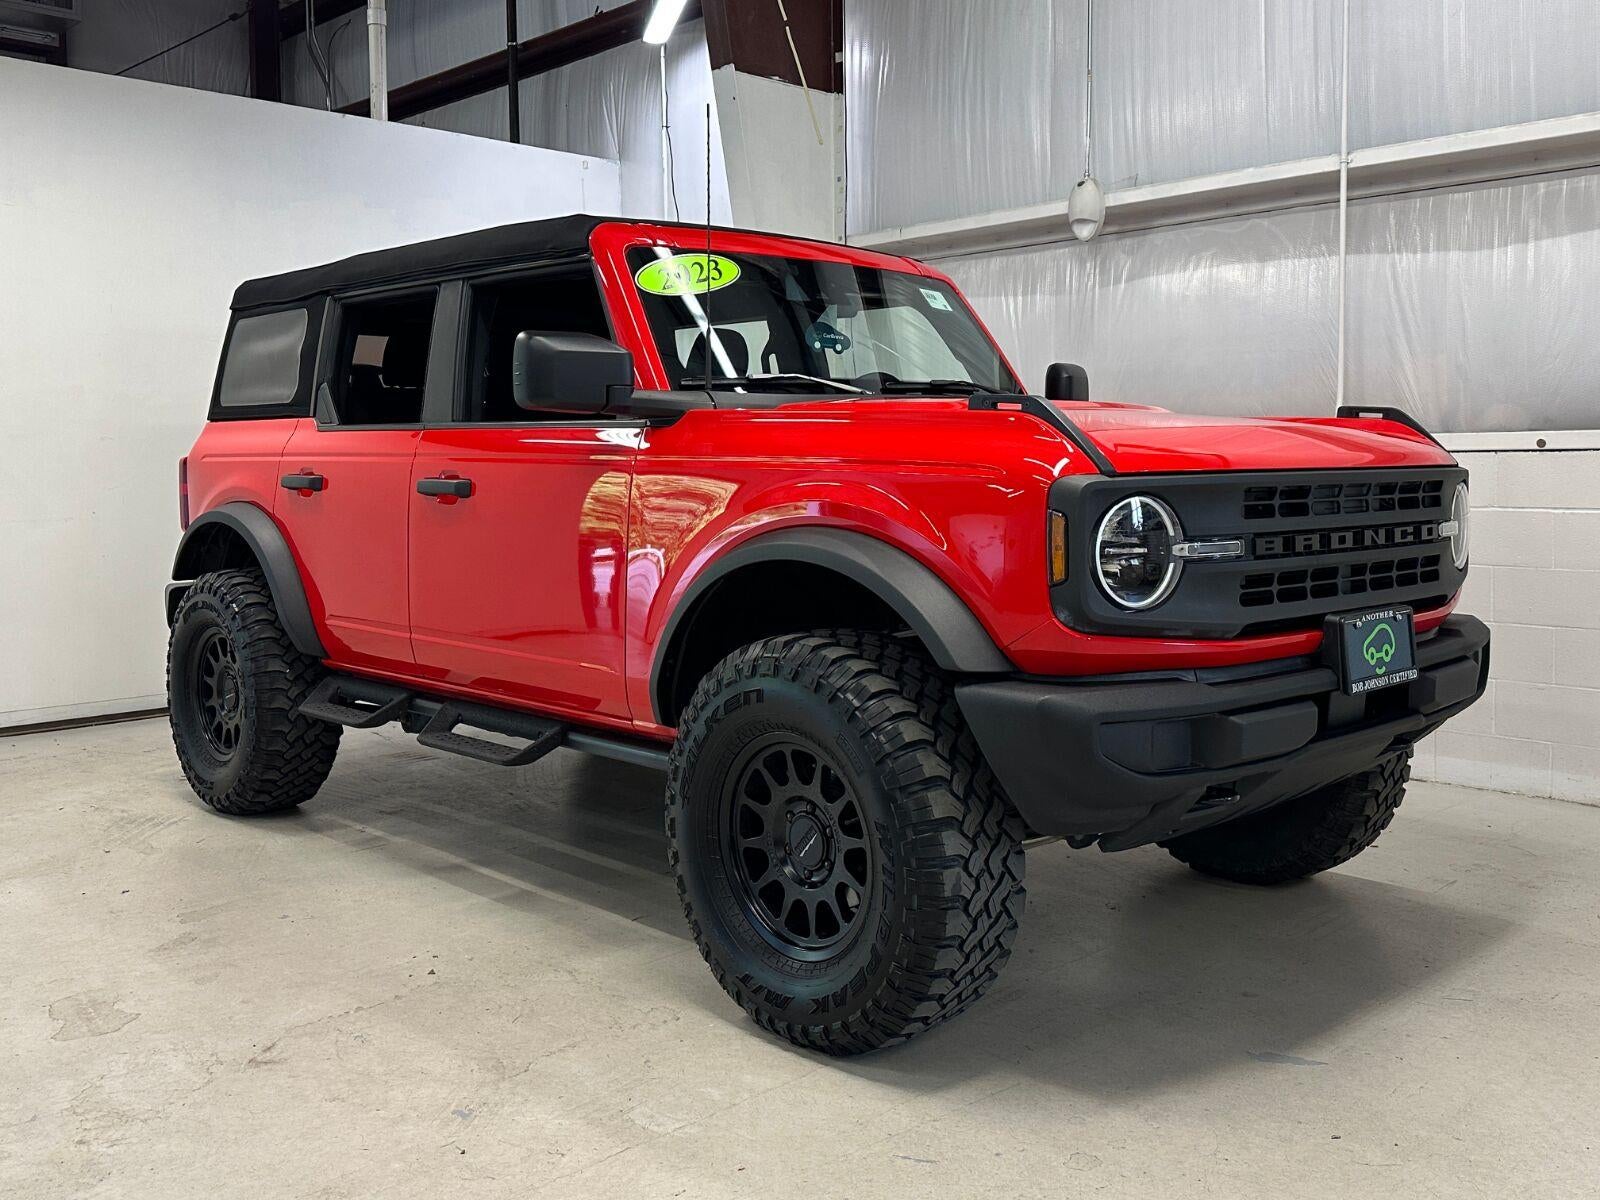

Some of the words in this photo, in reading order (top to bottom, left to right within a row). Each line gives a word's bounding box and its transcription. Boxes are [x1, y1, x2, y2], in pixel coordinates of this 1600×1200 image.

[658, 259, 723, 291] 2023
[1254, 523, 1439, 556] BRONCO
[1361, 610, 1394, 622] ANOTHER
[1352, 681, 1364, 693] BOB
[1364, 675, 1389, 691] JOHNSON
[1389, 669, 1418, 684] CERTIFIED
